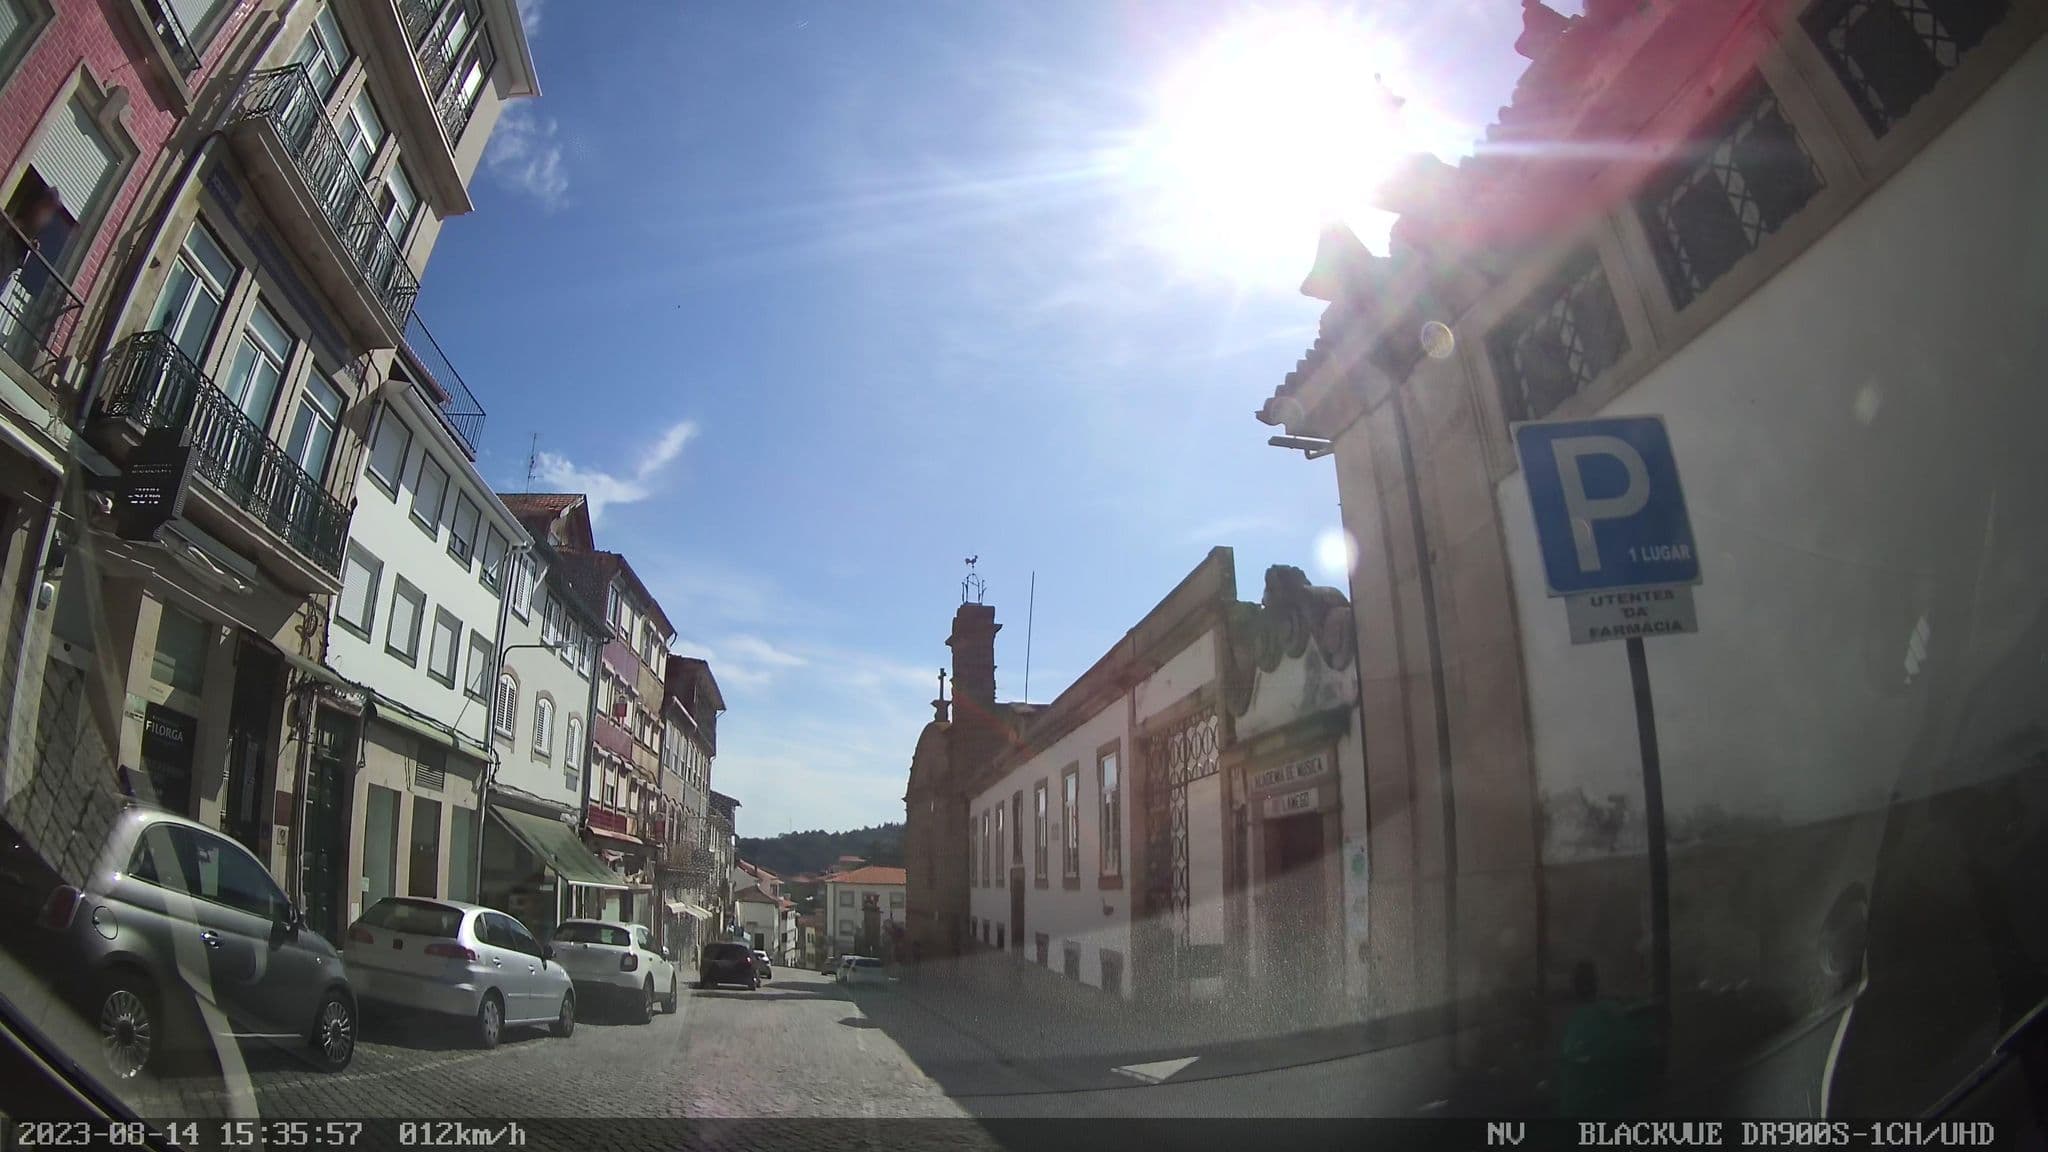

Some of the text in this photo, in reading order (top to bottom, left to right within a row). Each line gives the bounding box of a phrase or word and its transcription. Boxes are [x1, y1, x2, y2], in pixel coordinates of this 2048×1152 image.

[1551, 435, 1650, 572] P
[1628, 544, 1691, 562] 1 LUGAR
[1590, 589, 1675, 607] UTENTES
[1622, 606, 1648, 618] DA
[145, 720, 184, 742] FILORGA
